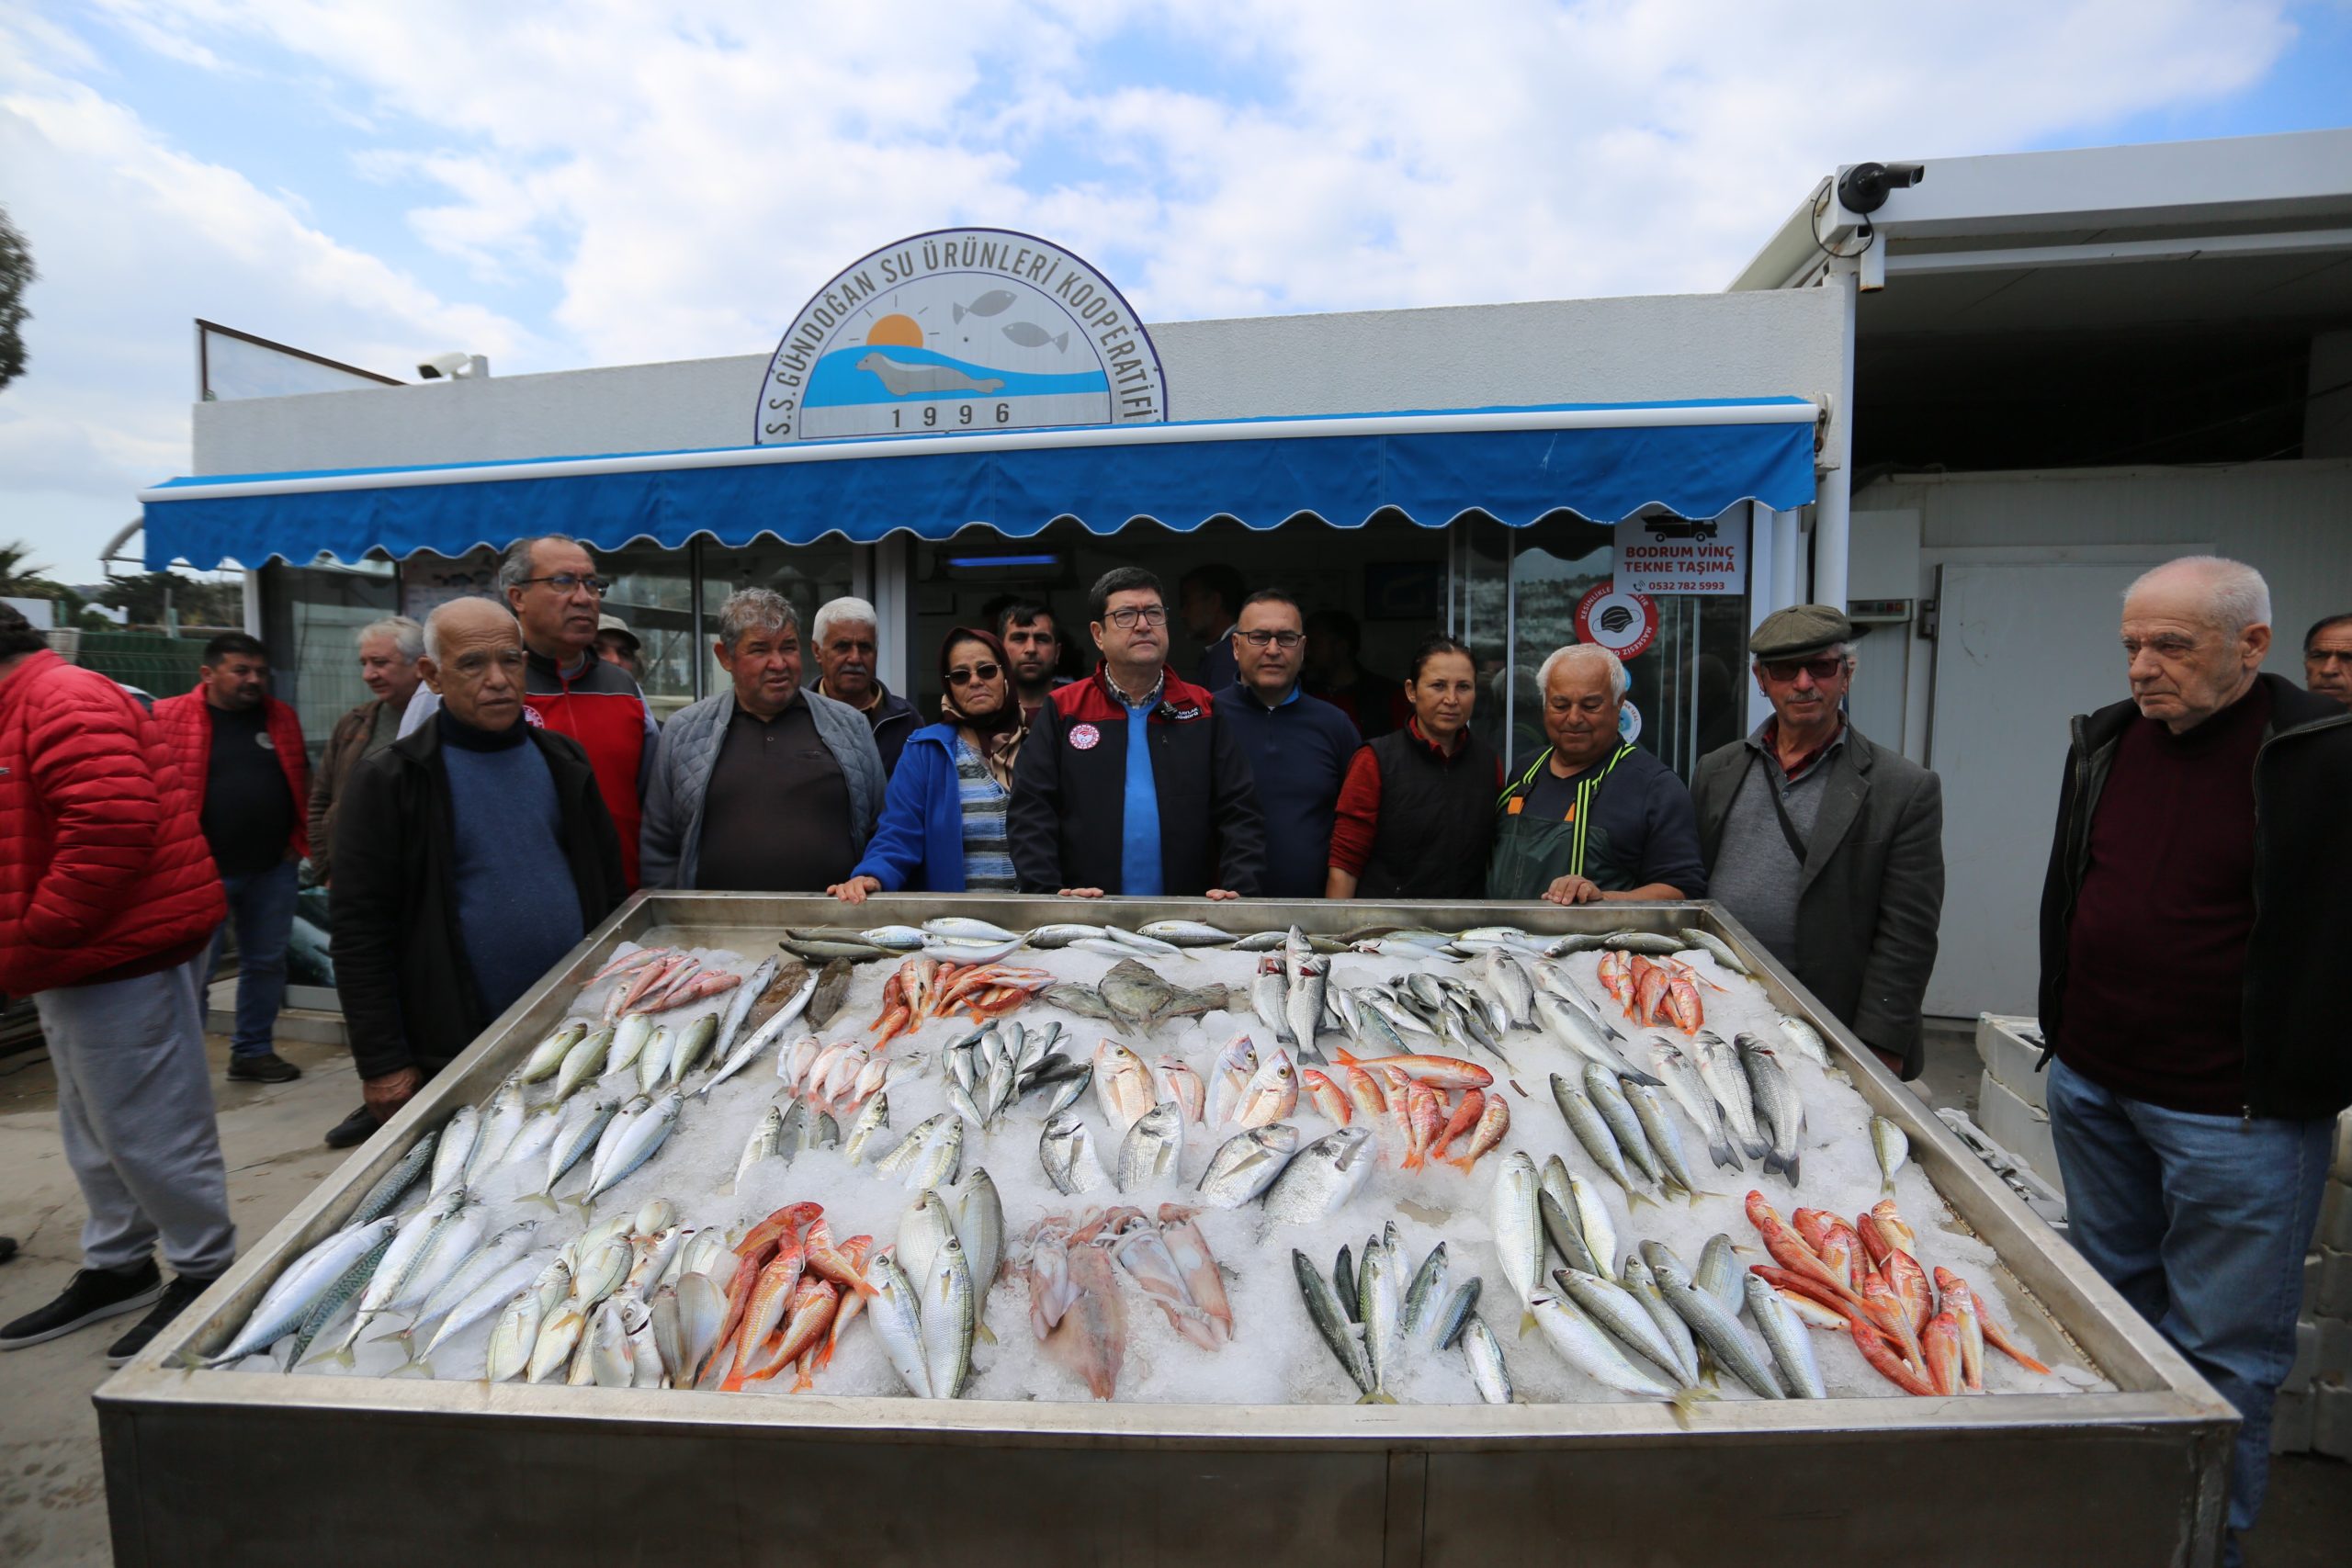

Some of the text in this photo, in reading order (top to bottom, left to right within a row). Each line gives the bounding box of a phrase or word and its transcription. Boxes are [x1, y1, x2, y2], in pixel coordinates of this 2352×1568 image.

[880, 251, 914, 283] SU
[922, 236, 1062, 286] ÜRÜNLERİ
[1056, 271, 1159, 418] KOOPERATİFİ
[892, 402, 1010, 428] 1996
[1625, 542, 1736, 560] BODRUM VİNÇ
[1624, 560, 1736, 576] TEKNE TAŞIMA
[1648, 581, 1725, 591] 0532 782 5993
